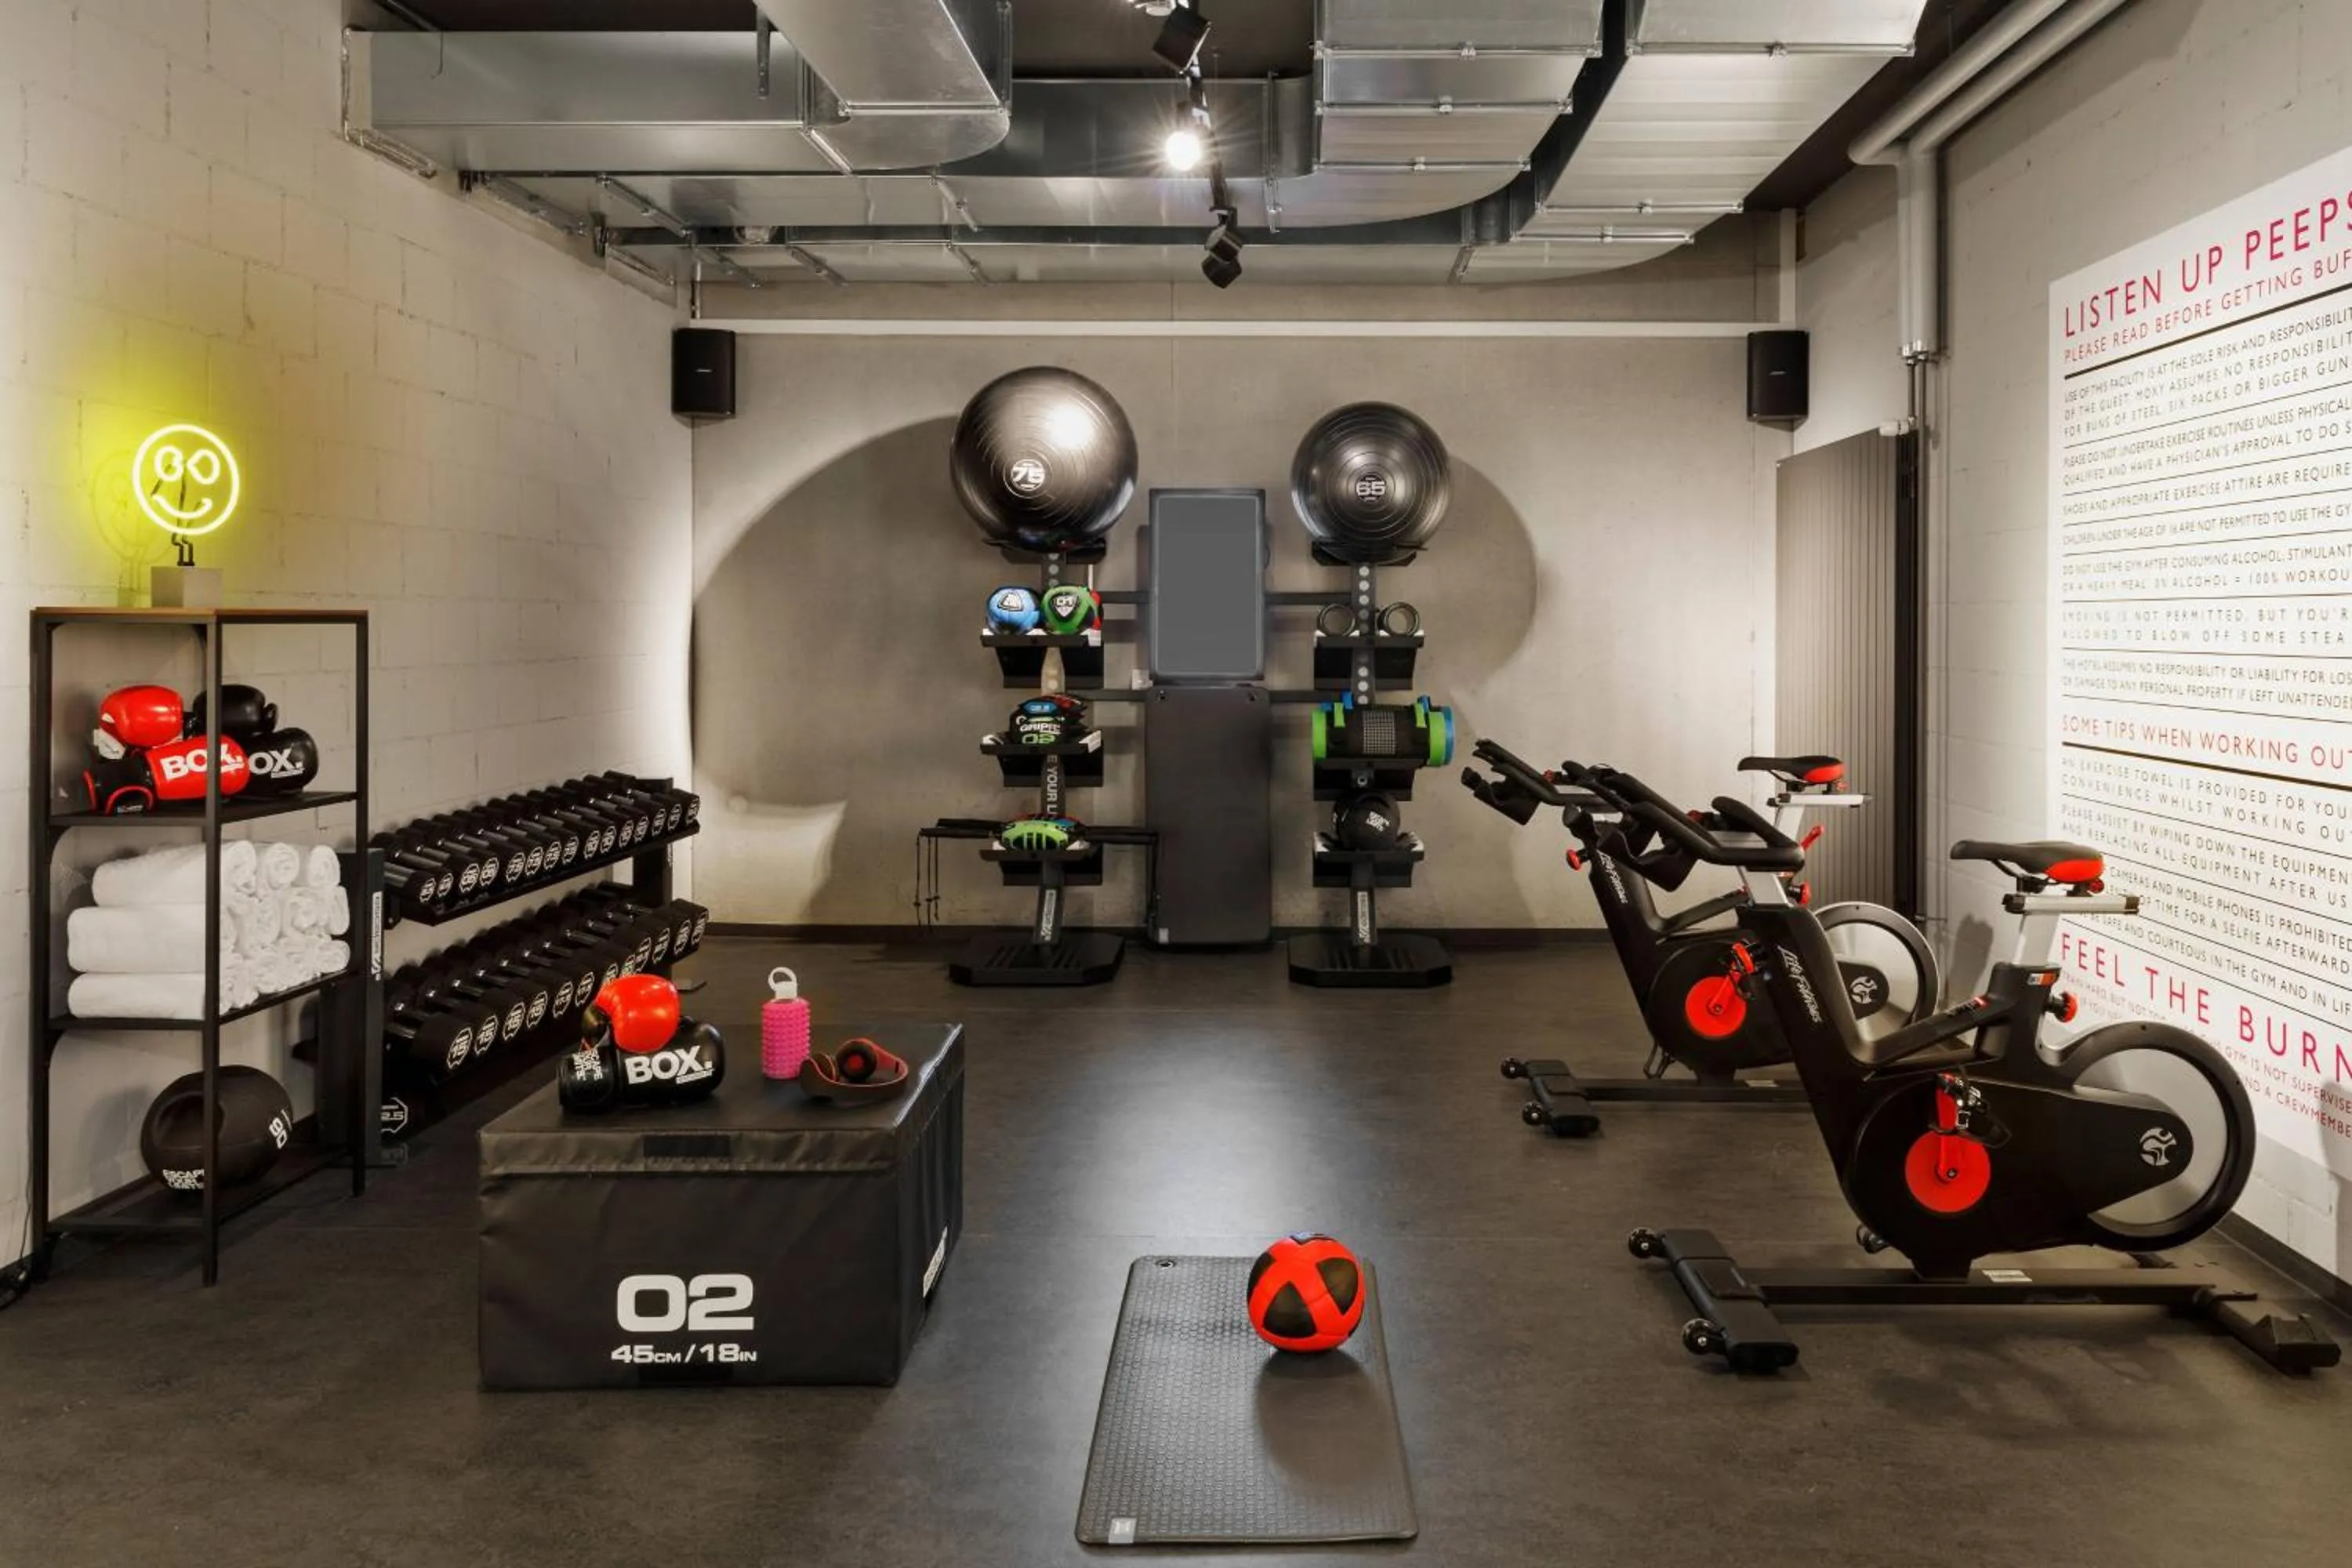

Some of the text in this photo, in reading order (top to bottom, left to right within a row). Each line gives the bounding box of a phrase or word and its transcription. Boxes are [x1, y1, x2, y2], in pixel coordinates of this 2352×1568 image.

[2065, 188, 2352, 338] LISTEN UP PEEP
[2064, 335, 2107, 365] PLEASE
[2113, 319, 2148, 349] READ
[2155, 296, 2212, 334] BEFORE
[2221, 263, 2303, 311] GETTING
[2169, 355, 2186, 374] THE
[2190, 347, 2213, 368] SOLE
[2217, 339, 2238, 361] RISK
[2241, 330, 2265, 354] AND
[2169, 366, 2217, 393] ASSUMES
[2224, 358, 2243, 378] NO
[2063, 423, 2080, 439] FOR
[2169, 396, 2184, 413] SIX
[2191, 385, 2227, 408] PACKS
[2235, 379, 2251, 397] OR
[2259, 364, 2307, 391] BIGGER
[2257, 407, 2294, 430] UNLESS
[2234, 430, 2292, 456] APPROVAL
[2296, 426, 2313, 444] TO
[2318, 420, 2339, 440] DO
[1012, 466, 1044, 484] 75
[1356, 481, 1386, 496] 65
[2173, 480, 2220, 501] EXERCISE
[2224, 474, 2262, 494] ATTIRE
[2267, 469, 2288, 488] ARE
[2294, 459, 2350, 484] REQUIRE
[2198, 517, 2216, 532] NOT
[2220, 510, 2269, 530] PERMITTED
[2273, 508, 2286, 524] TO
[2289, 506, 2308, 523] USE
[2311, 503, 2330, 521] THE
[2172, 573, 2227, 588] ALCOHOL
[2134, 607, 2285, 622] NOT BUT
[2202, 630, 2230, 642] OFF
[2241, 630, 2284, 643] SOME
[2155, 662, 2226, 678] RESPONSIBILITY
[2230, 666, 2244, 680] OR
[2248, 666, 2297, 683] LIABILITY
[2303, 669, 2325, 684] FOR
[2187, 684, 2233, 699] PROPERTY
[2237, 687, 2245, 701] IF
[2249, 688, 2272, 702] LEFT
[2062, 713, 2100, 735] SOME
[2103, 718, 2134, 740] TIPS
[2140, 723, 2190, 748] WHEN
[2199, 729, 2298, 763] WORKING
[249, 744, 304, 776] OX.
[1047, 766, 1058, 802] YOUR
[2133, 768, 2303, 811] TOWEL IS PROVIDED FOR
[2158, 792, 2304, 835] WHILST WORKING
[2150, 823, 2190, 847] WIPING
[2198, 835, 2234, 858] DOWN
[2240, 844, 2265, 866] THE
[2155, 845, 2175, 862] ALL
[2182, 852, 2260, 885] EQUIPMENT
[2269, 875, 2316, 901] AFTER
[2152, 878, 2172, 896] AND
[2176, 885, 2212, 909] MOBILE
[2216, 897, 2260, 924] PHONES
[2264, 912, 2274, 928] IS
[2155, 898, 2178, 919] TIME
[2184, 908, 2204, 928] FOR
[2210, 916, 2217, 932] A
[2223, 920, 2260, 947] SELFIE
[2061, 931, 2125, 988] FEEL
[2144, 965, 2209, 1025] THE
[2147, 929, 2206, 964] COURTEOUS
[2210, 953, 2222, 969] IN
[2226, 958, 2246, 978] THE
[2250, 967, 2275, 989] GYM
[2280, 978, 2307, 1001] AND
[2313, 989, 2326, 1008] IN
[2224, 1043, 2248, 1067] GYM
[2250, 1054, 2259, 1073] IS
[2263, 1061, 2286, 1086] NOT
[381, 1111, 404, 1121] 2.5
[617, 1273, 754, 1332] 02
